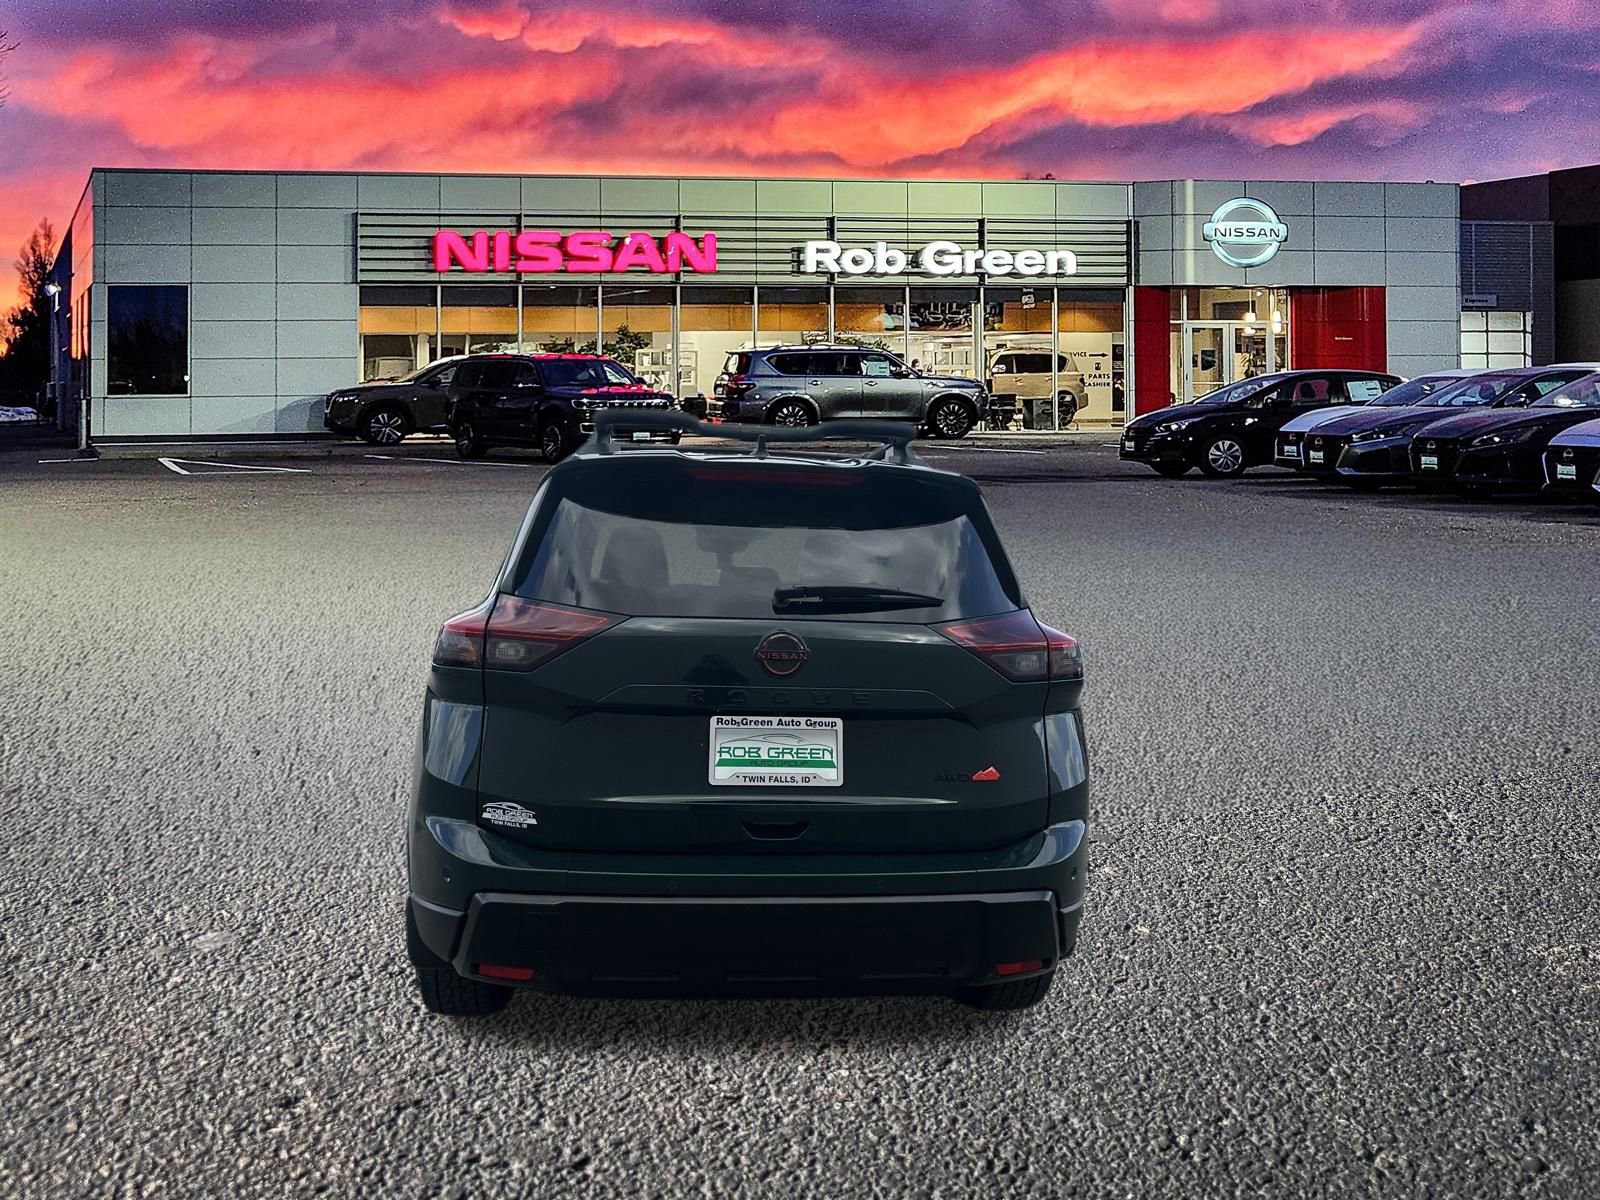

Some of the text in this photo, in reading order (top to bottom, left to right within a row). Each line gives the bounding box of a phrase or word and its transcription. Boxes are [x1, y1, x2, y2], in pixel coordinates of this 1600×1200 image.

[1214, 227, 1280, 238] NISSAN
[434, 230, 718, 273] NISSAN
[804, 240, 1078, 275] Rob Green
[757, 651, 808, 660] NISSAN
[687, 688, 871, 705] ROGUE
[716, 717, 838, 729] Rob Green Auto Group
[717, 746, 834, 760] ROB GREEN
[742, 775, 765, 783] TWIN
[768, 775, 799, 784] FALLS,
